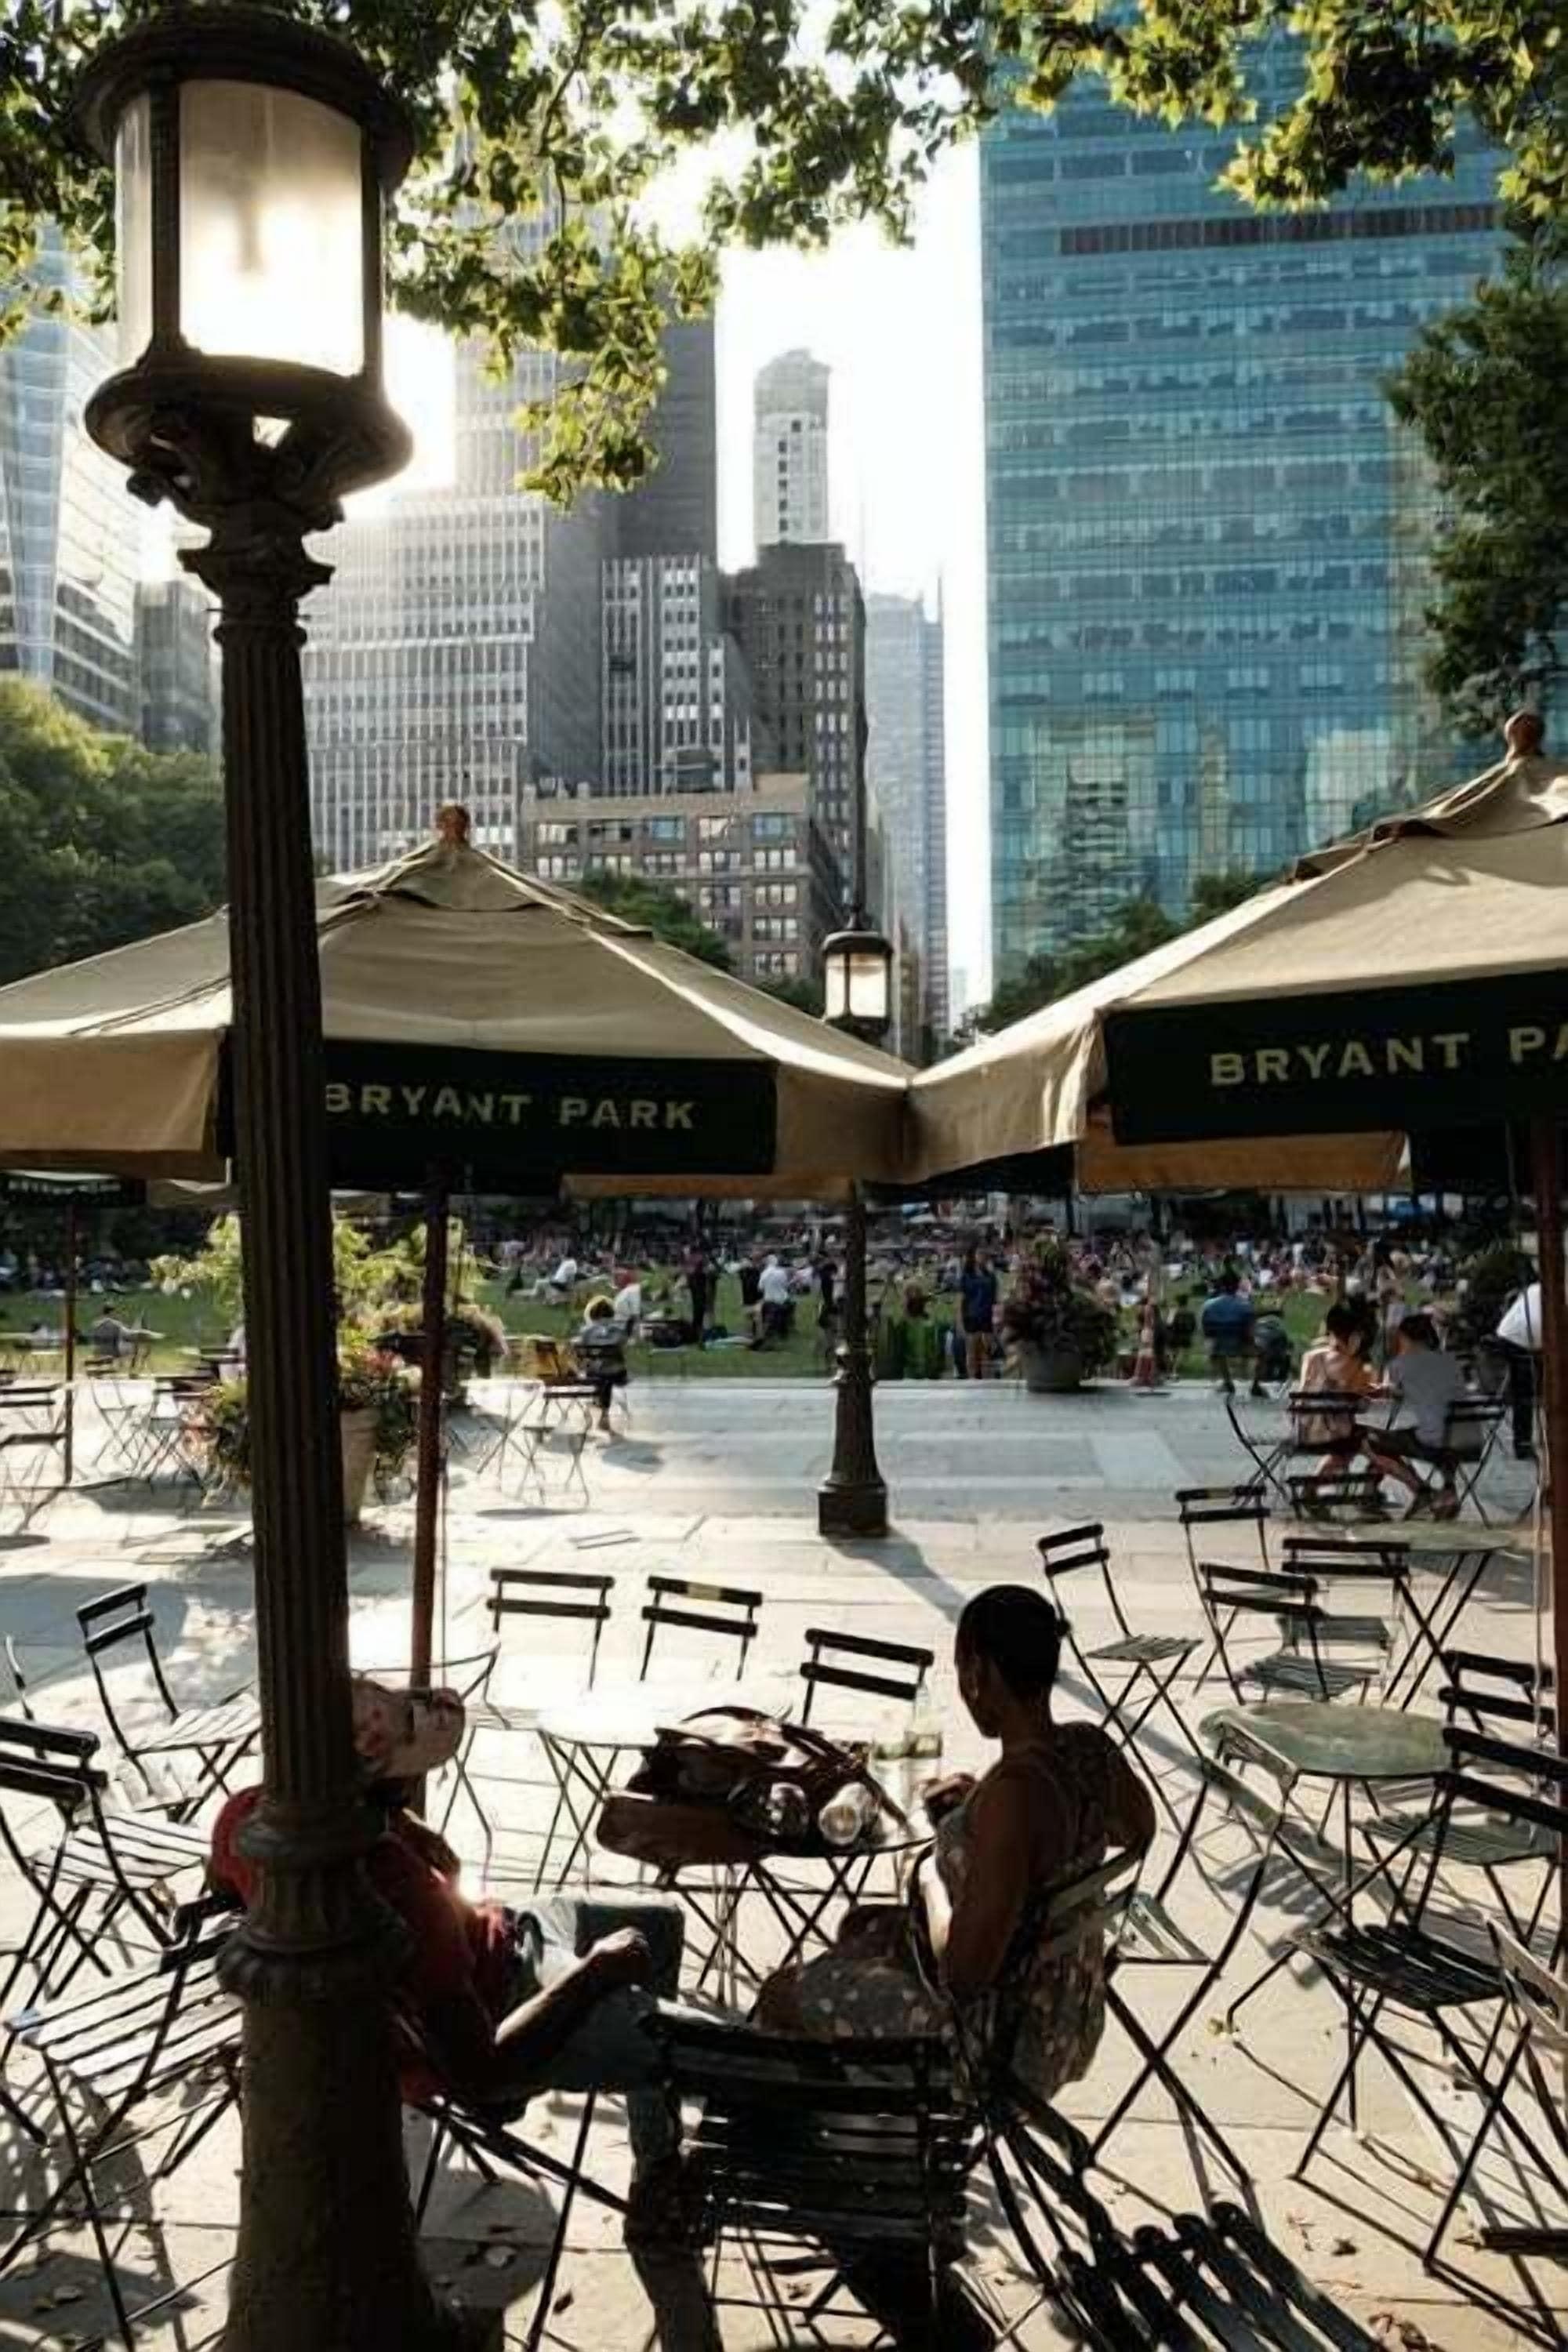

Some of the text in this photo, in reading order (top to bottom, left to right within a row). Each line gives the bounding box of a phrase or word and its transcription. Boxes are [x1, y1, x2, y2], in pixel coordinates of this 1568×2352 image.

[1210, 1033, 1470, 1086] BRYANT
[325, 1083, 694, 1130] BRYANT PARK
